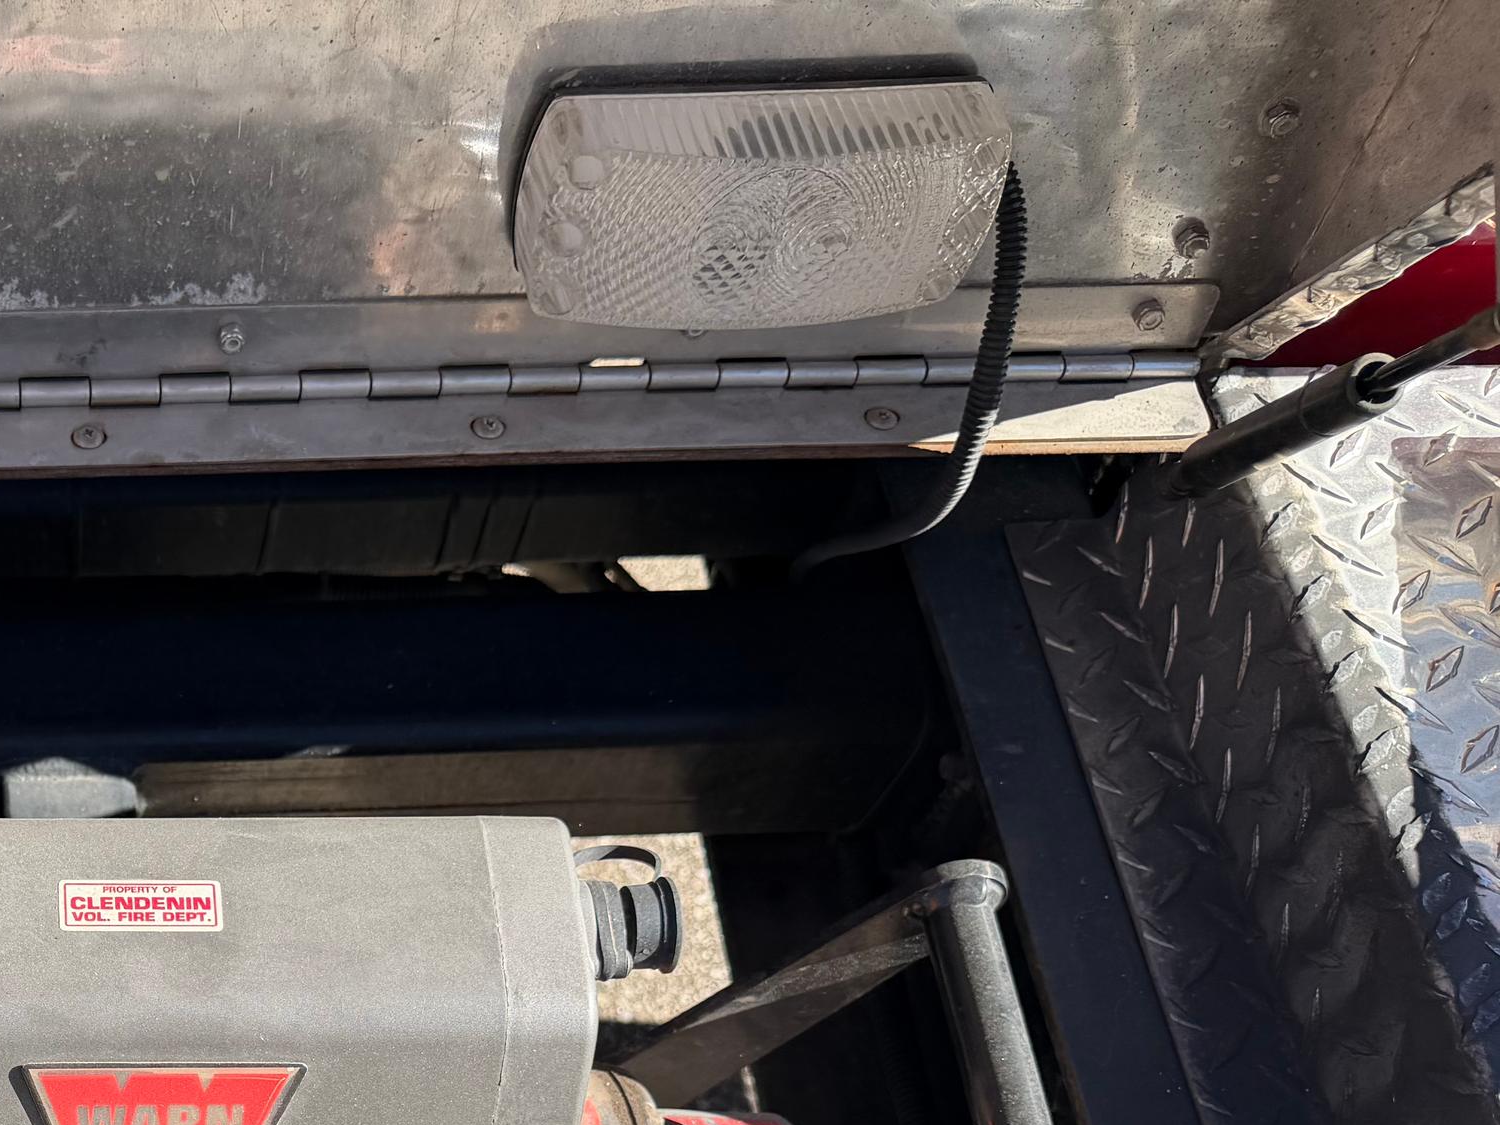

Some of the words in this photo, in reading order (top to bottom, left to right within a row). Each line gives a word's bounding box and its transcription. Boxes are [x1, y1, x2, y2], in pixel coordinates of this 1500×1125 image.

[70, 896, 211, 910] CLENDENIN
[71, 911, 111, 922] VOL.
[117, 911, 156, 922] FIRE
[162, 911, 211, 922] DEPT.
